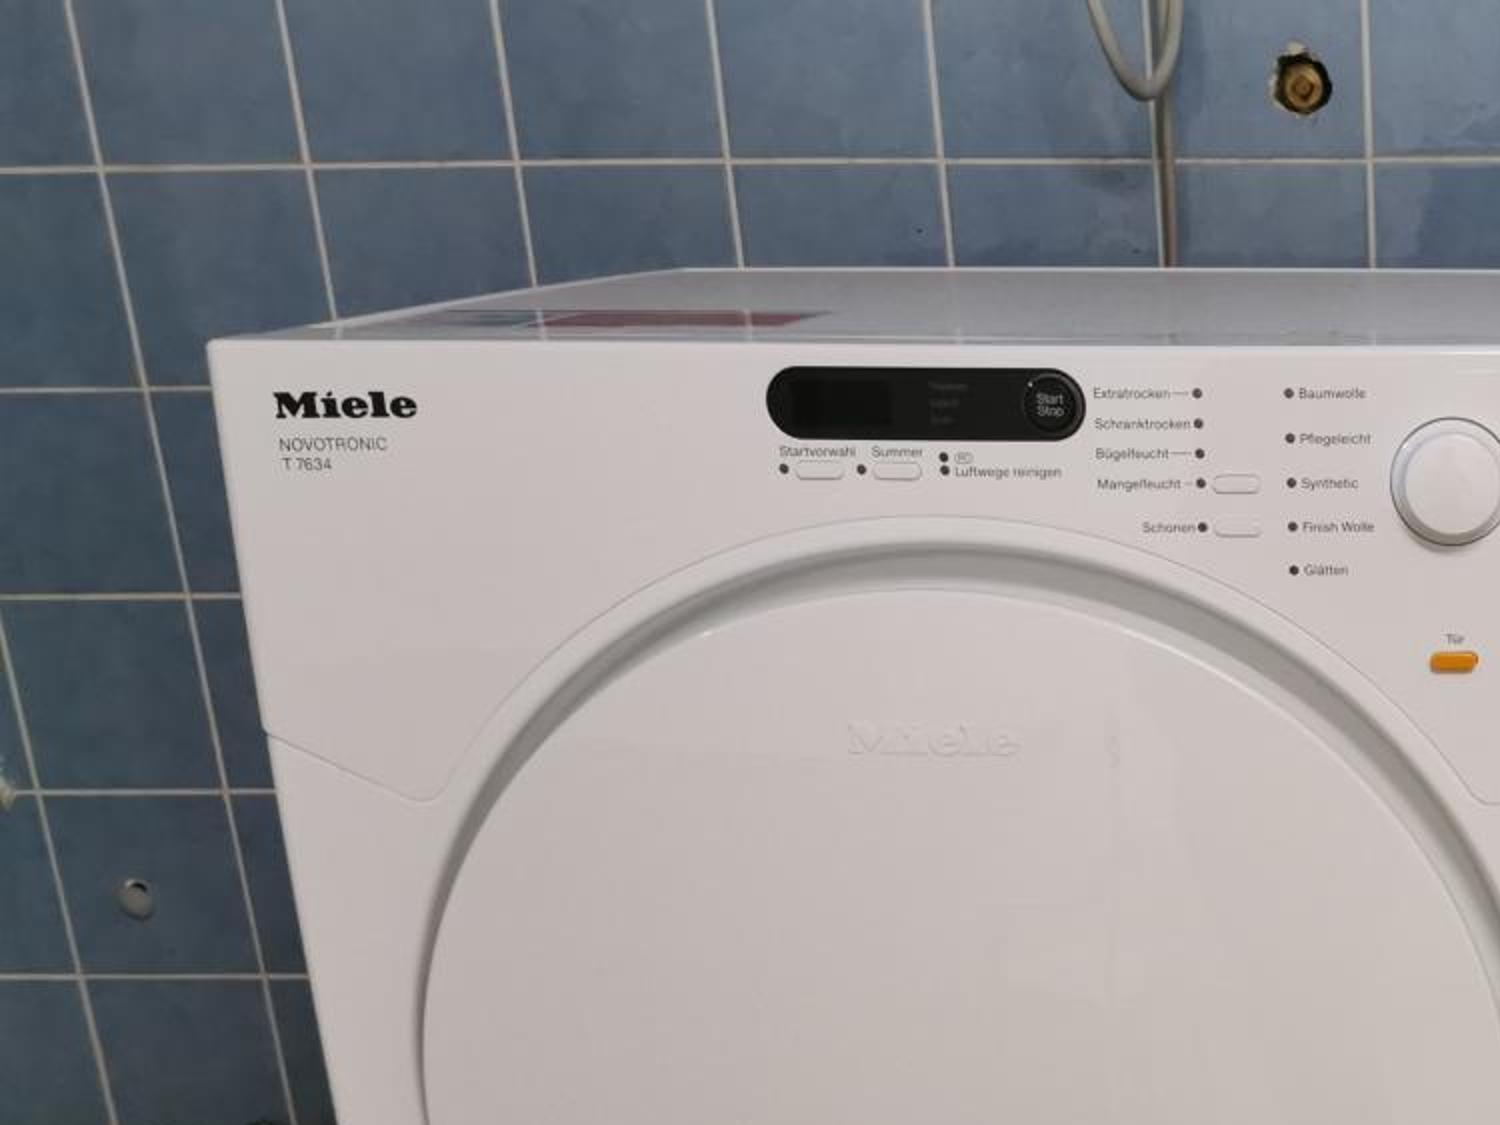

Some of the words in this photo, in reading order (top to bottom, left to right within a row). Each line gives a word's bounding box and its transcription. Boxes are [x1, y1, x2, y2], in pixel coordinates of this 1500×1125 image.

[1036, 392, 1063, 405] Start
[1093, 387, 1171, 399] Extratrocken
[1298, 387, 1367, 399] Baumwolle
[273, 391, 418, 418] Miele
[1036, 405, 1064, 418] Stop
[1094, 418, 1191, 430] Schranktrocken
[278, 437, 388, 451] NOVOTRONIC
[1300, 433, 1371, 447] Pflegeleicht
[779, 446, 857, 458] Startvorwahl
[871, 446, 923, 458] Summer
[1096, 447, 1169, 461] Bügelfeucht
[282, 457, 291, 470] T
[296, 457, 332, 471] 7634
[955, 466, 1009, 479] Luftwege
[1013, 467, 1062, 479] reinigen
[1097, 478, 1182, 491] Mangelfeucht
[1301, 477, 1359, 490] Synthetic
[1142, 521, 1196, 533] Schonen
[1302, 521, 1339, 533] Finish
[1341, 521, 1375, 533] Wolle
[1304, 564, 1349, 577] Glätten
